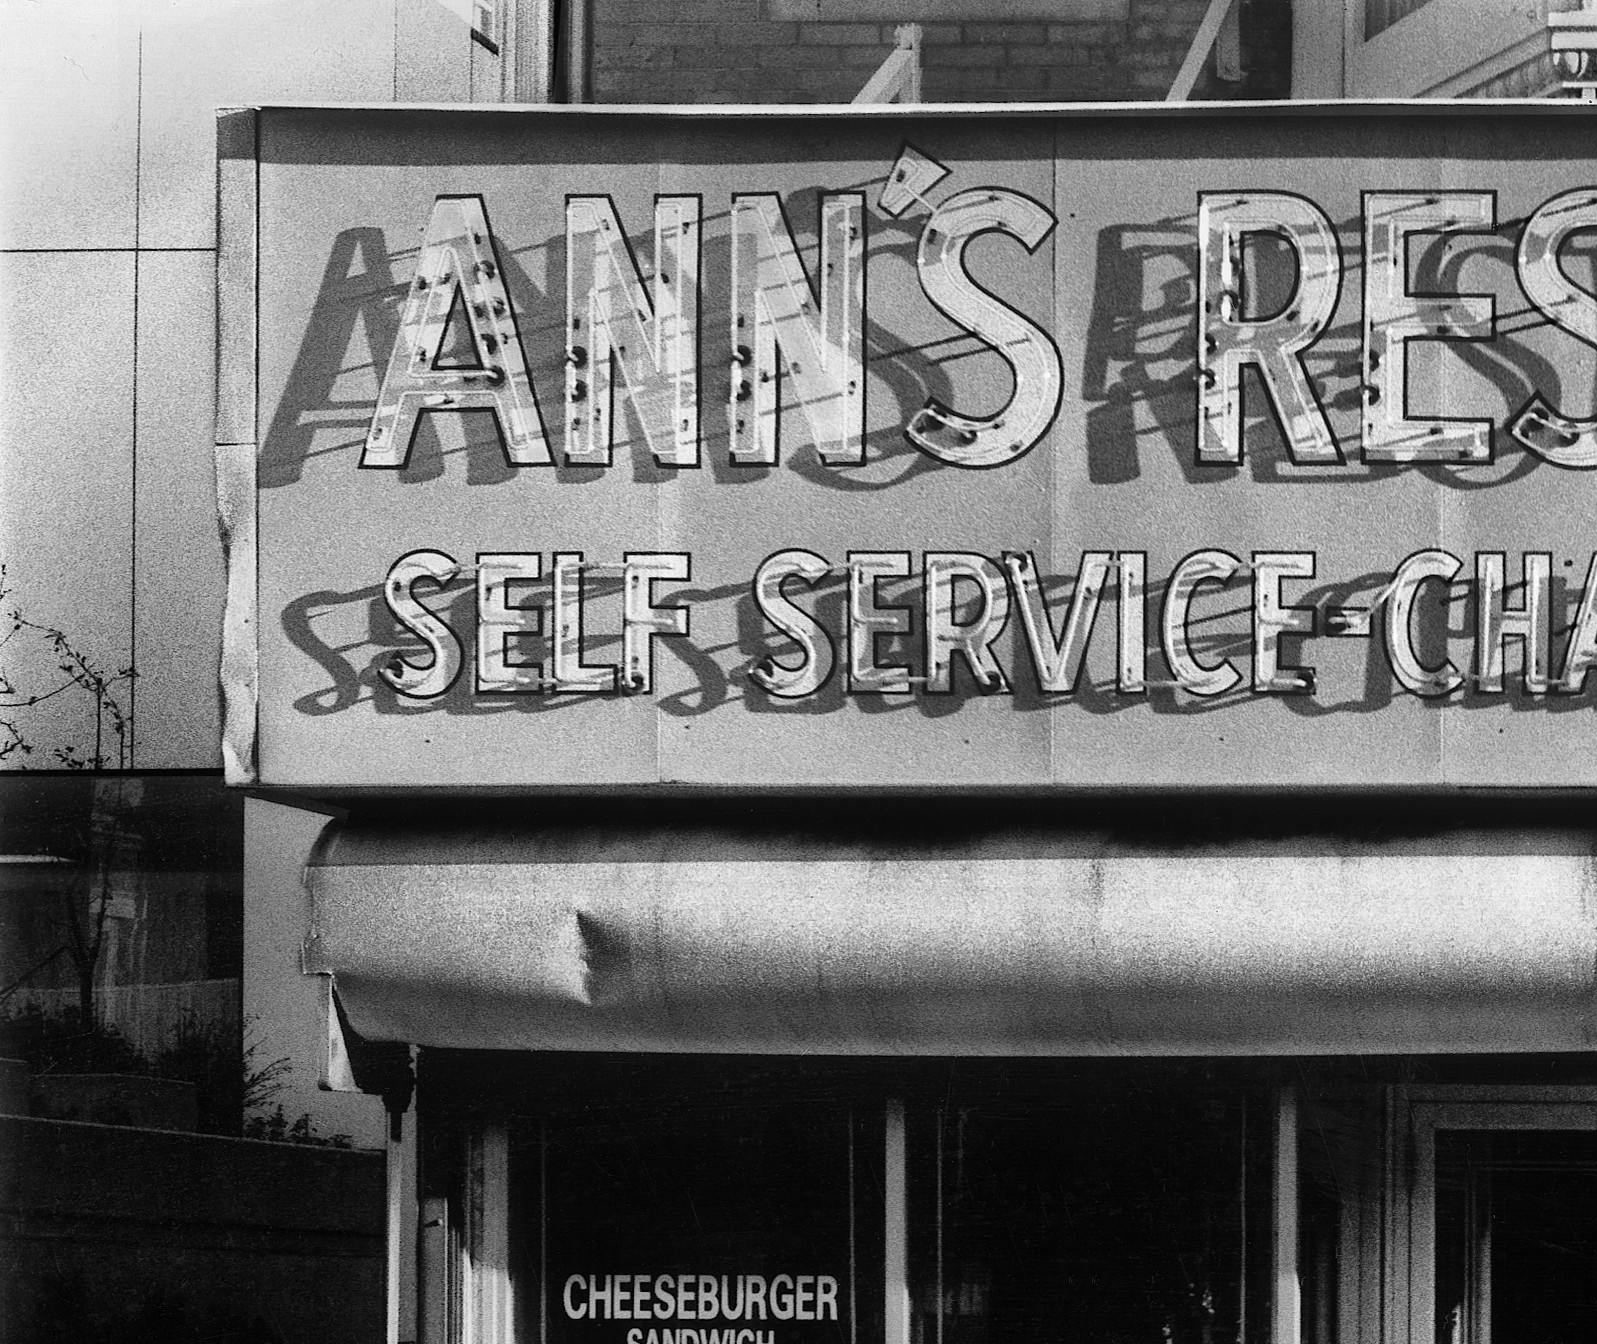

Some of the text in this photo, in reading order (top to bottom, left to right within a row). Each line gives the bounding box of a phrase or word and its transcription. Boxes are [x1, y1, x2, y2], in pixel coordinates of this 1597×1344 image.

[360, 142, 1064, 468] ANN'S
[377, 548, 691, 700] SELF
[563, 1274, 838, 1320] CHEESEBURGER
